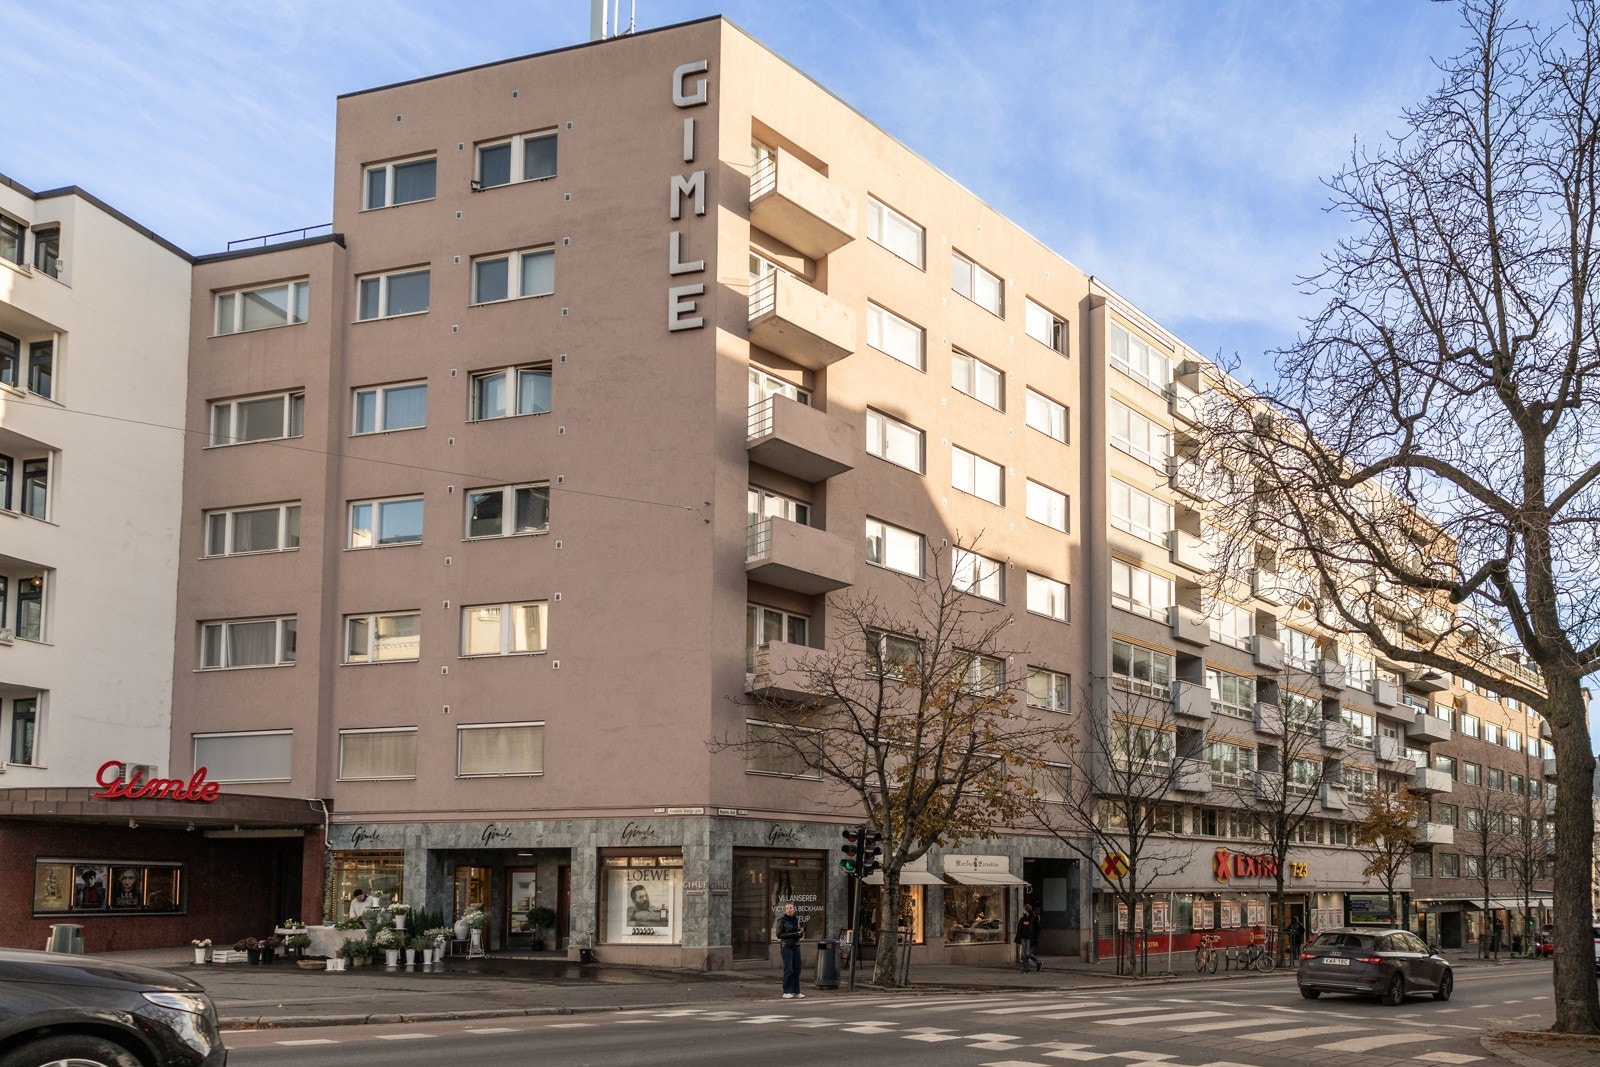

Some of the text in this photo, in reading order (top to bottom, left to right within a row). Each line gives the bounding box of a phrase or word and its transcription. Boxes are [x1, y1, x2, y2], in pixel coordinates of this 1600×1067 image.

[668, 59, 708, 332] GIMLE
[93, 760, 220, 801] Gimle
[351, 826, 384, 847] Gimle
[481, 824, 517, 846] Gimle
[621, 822, 660, 844] Gimle
[768, 824, 800, 845] Gimle
[626, 869, 671, 881] LOEWE
